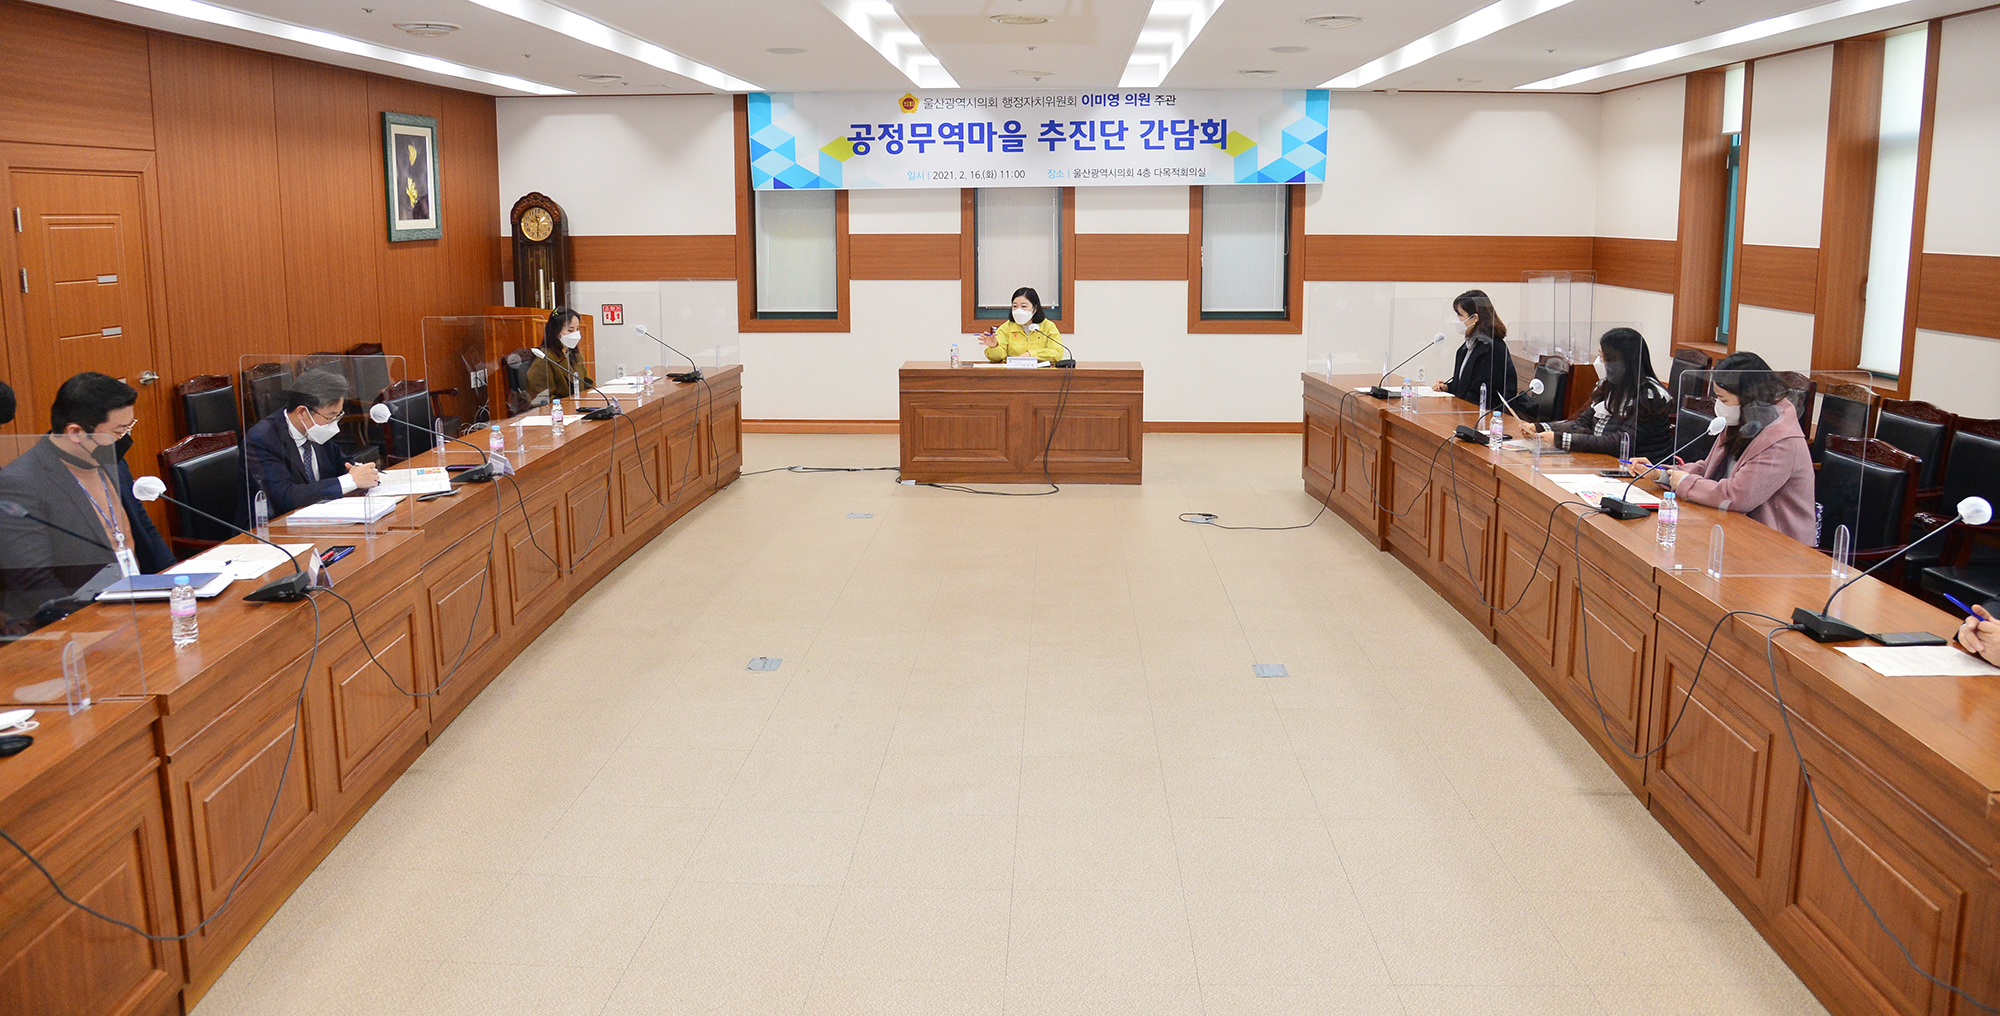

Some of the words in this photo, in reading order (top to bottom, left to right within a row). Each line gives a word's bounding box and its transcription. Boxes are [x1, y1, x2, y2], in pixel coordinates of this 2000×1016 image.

[923, 97, 998, 109] 울산광역시의회
[1002, 96, 1077, 108] 행정자치위원회
[1081, 93, 1120, 107] 이미영
[1125, 92, 1151, 107] 의원
[1154, 94, 1176, 106] 주관
[847, 120, 1027, 155] 공정무역마을
[1037, 119, 1129, 151] 추진단
[1139, 118, 1227, 151] 간담회
[907, 170, 925, 181] 일시
[932, 170, 957, 180] 2021.
[1000, 169, 1026, 179] 11:00
[1047, 168, 1065, 179] 장소
[1073, 168, 1134, 179] 울산광역시의회
[1136, 168, 1151, 178] 4층
[1153, 167, 1206, 178] 다목적회의실
